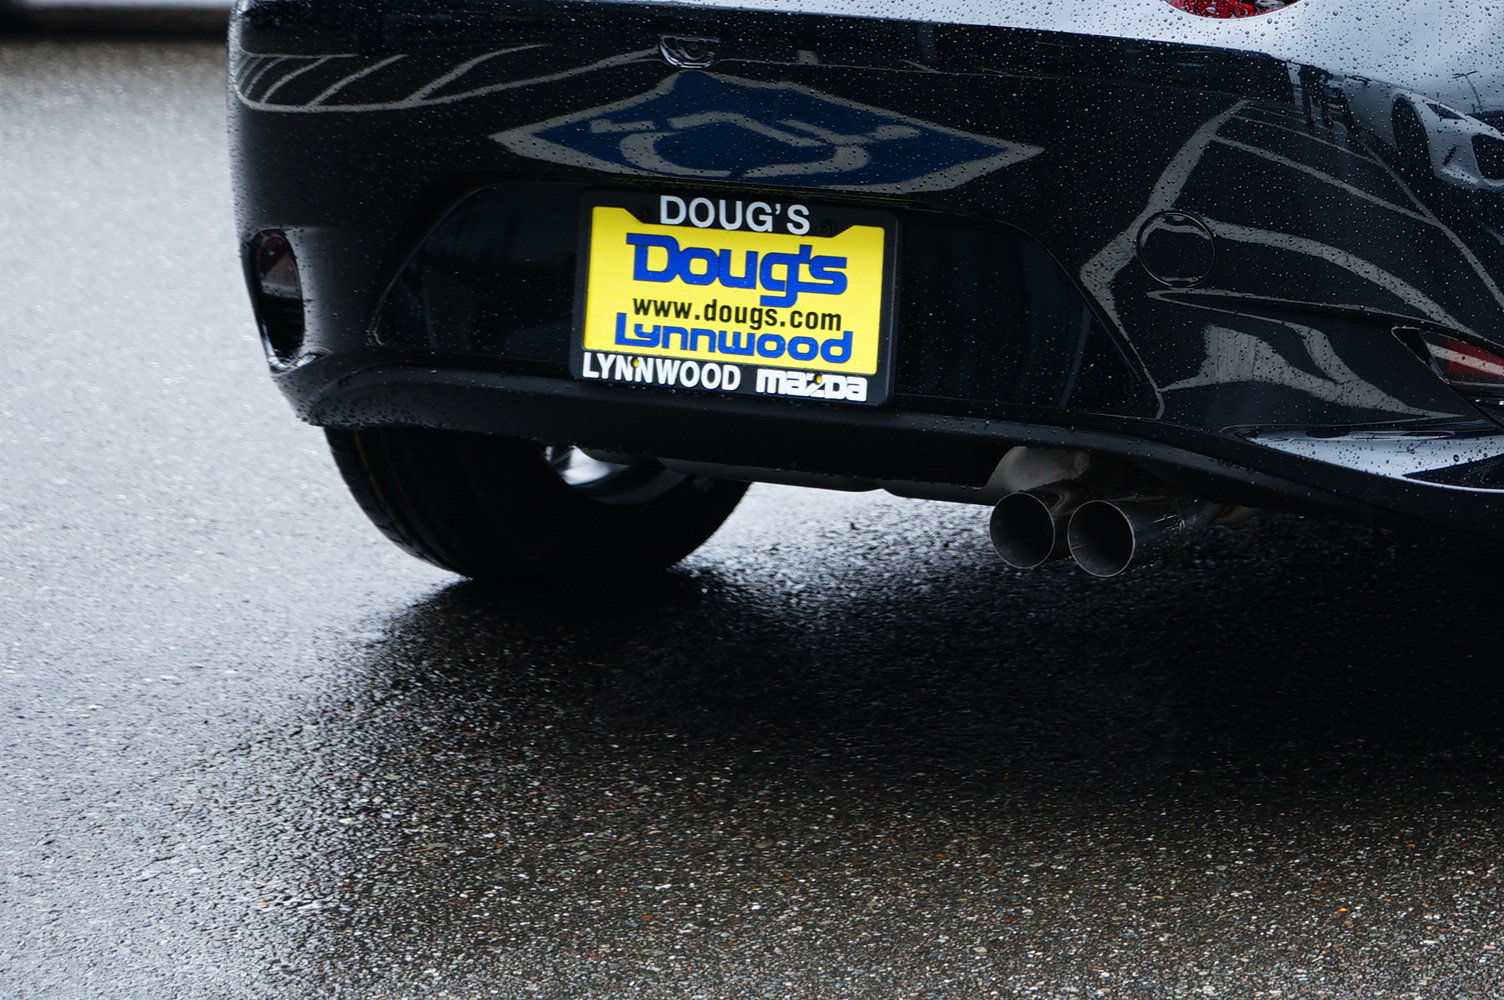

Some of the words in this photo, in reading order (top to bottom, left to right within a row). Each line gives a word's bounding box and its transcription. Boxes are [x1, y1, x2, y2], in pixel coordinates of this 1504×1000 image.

[659, 195, 811, 235] DOUG'S
[625, 232, 848, 308] Doug's
[632, 298, 842, 332] www.dougs.com
[614, 312, 854, 364] Lynnwood
[582, 352, 741, 391] LYNNWOOD
